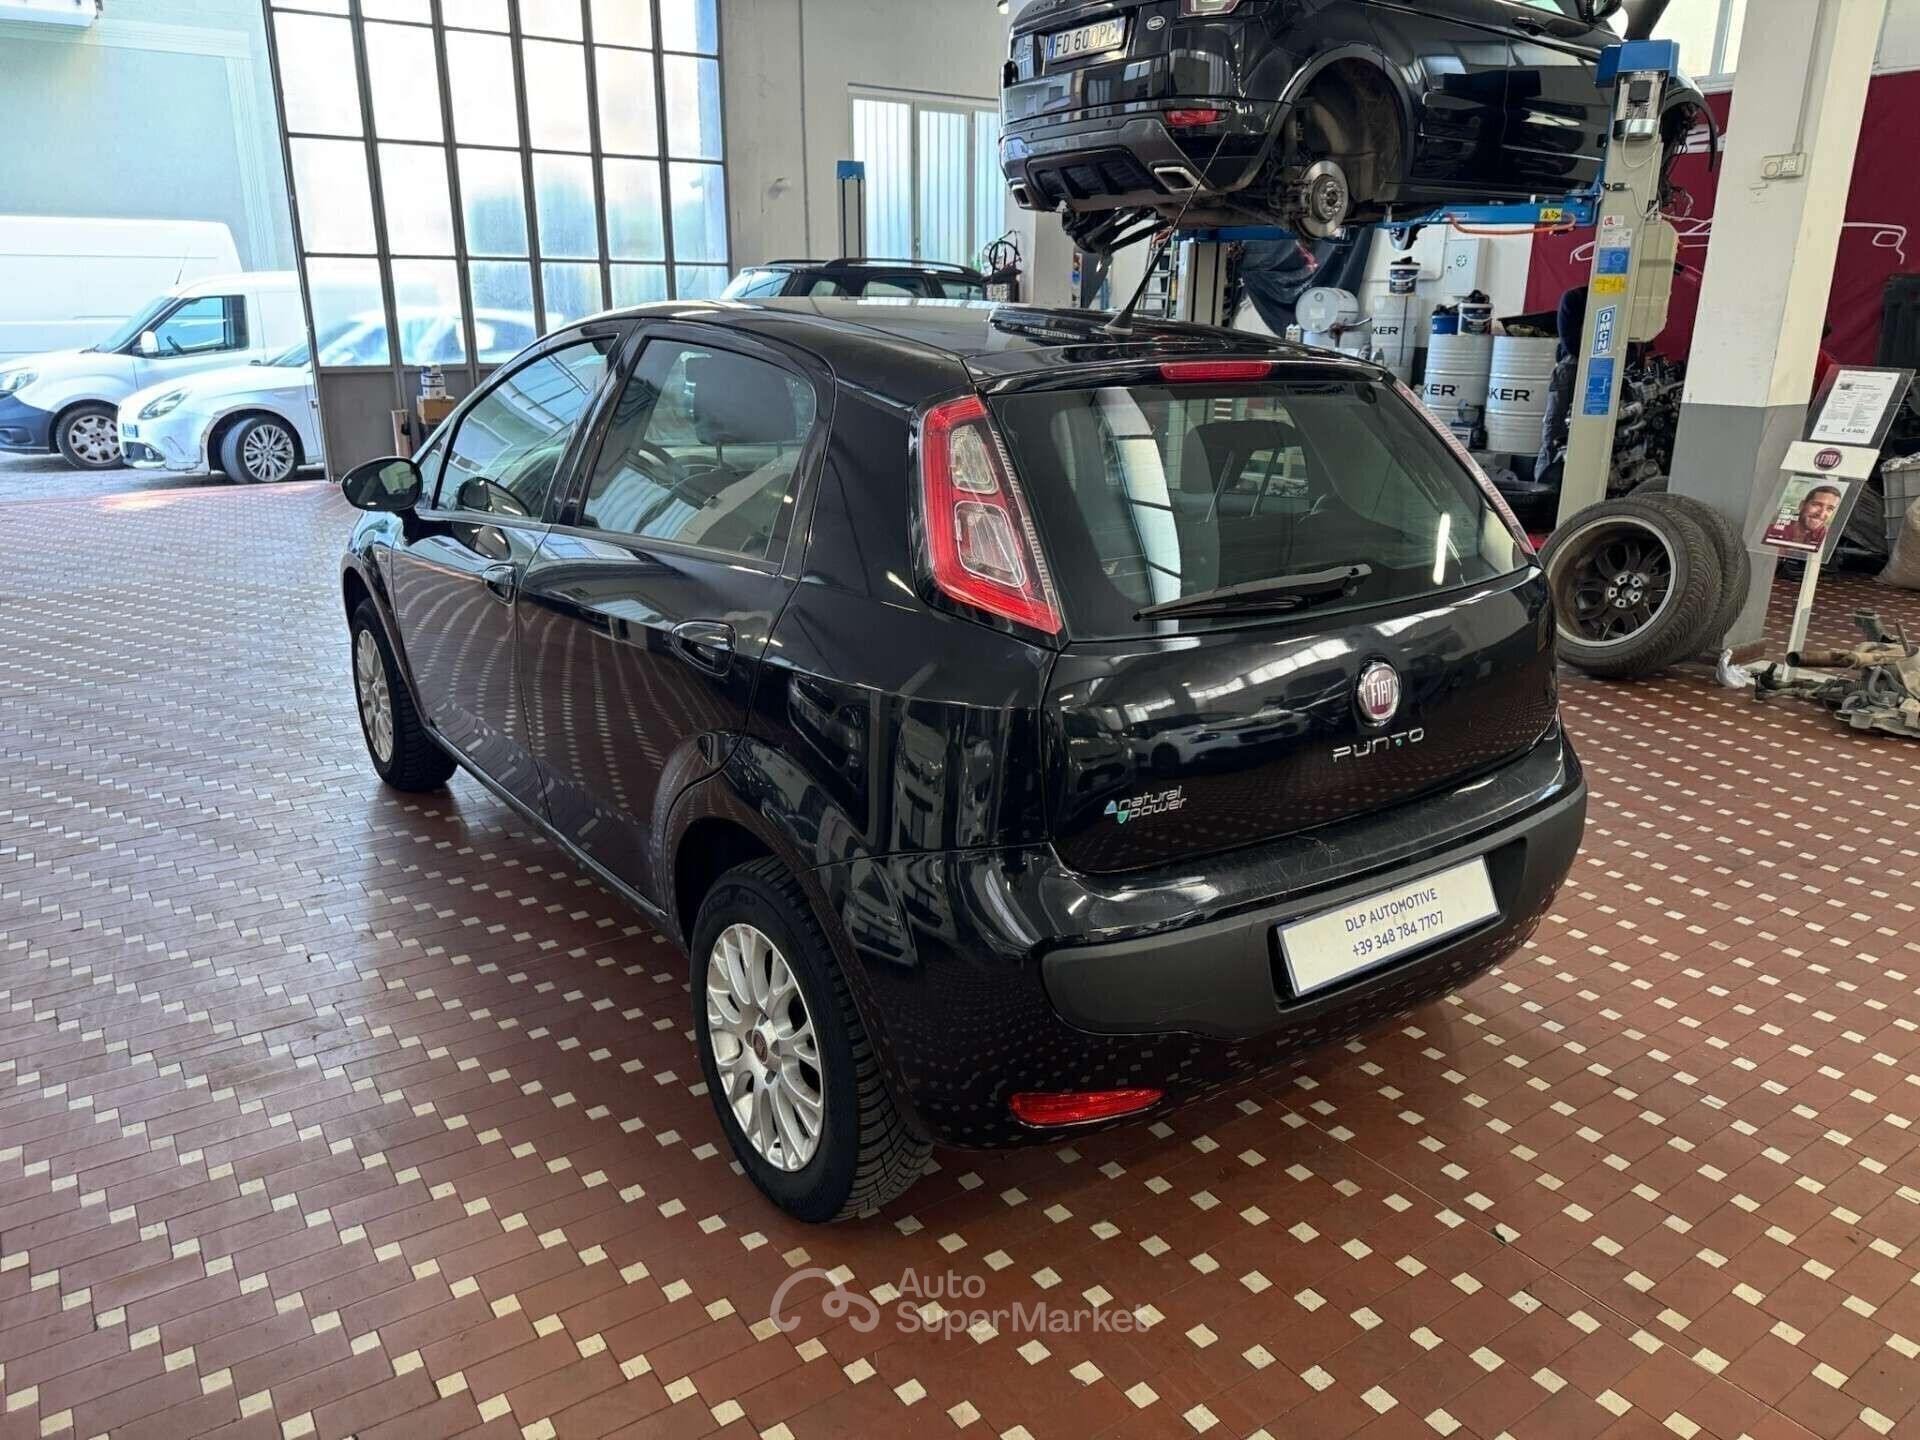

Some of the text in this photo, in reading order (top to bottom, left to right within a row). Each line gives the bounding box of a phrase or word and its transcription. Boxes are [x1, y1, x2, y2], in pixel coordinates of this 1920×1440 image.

[1055, 34, 1070, 56] FD
[1597, 312, 1611, 351] OMCN
[1369, 679, 1392, 707] FIAT
[1117, 785, 1183, 810] natural
[1128, 796, 1187, 821] power
[1345, 888, 1437, 932] DLP AUTOMOTIVE
[1352, 911, 1444, 957] +39 348 784 7707
